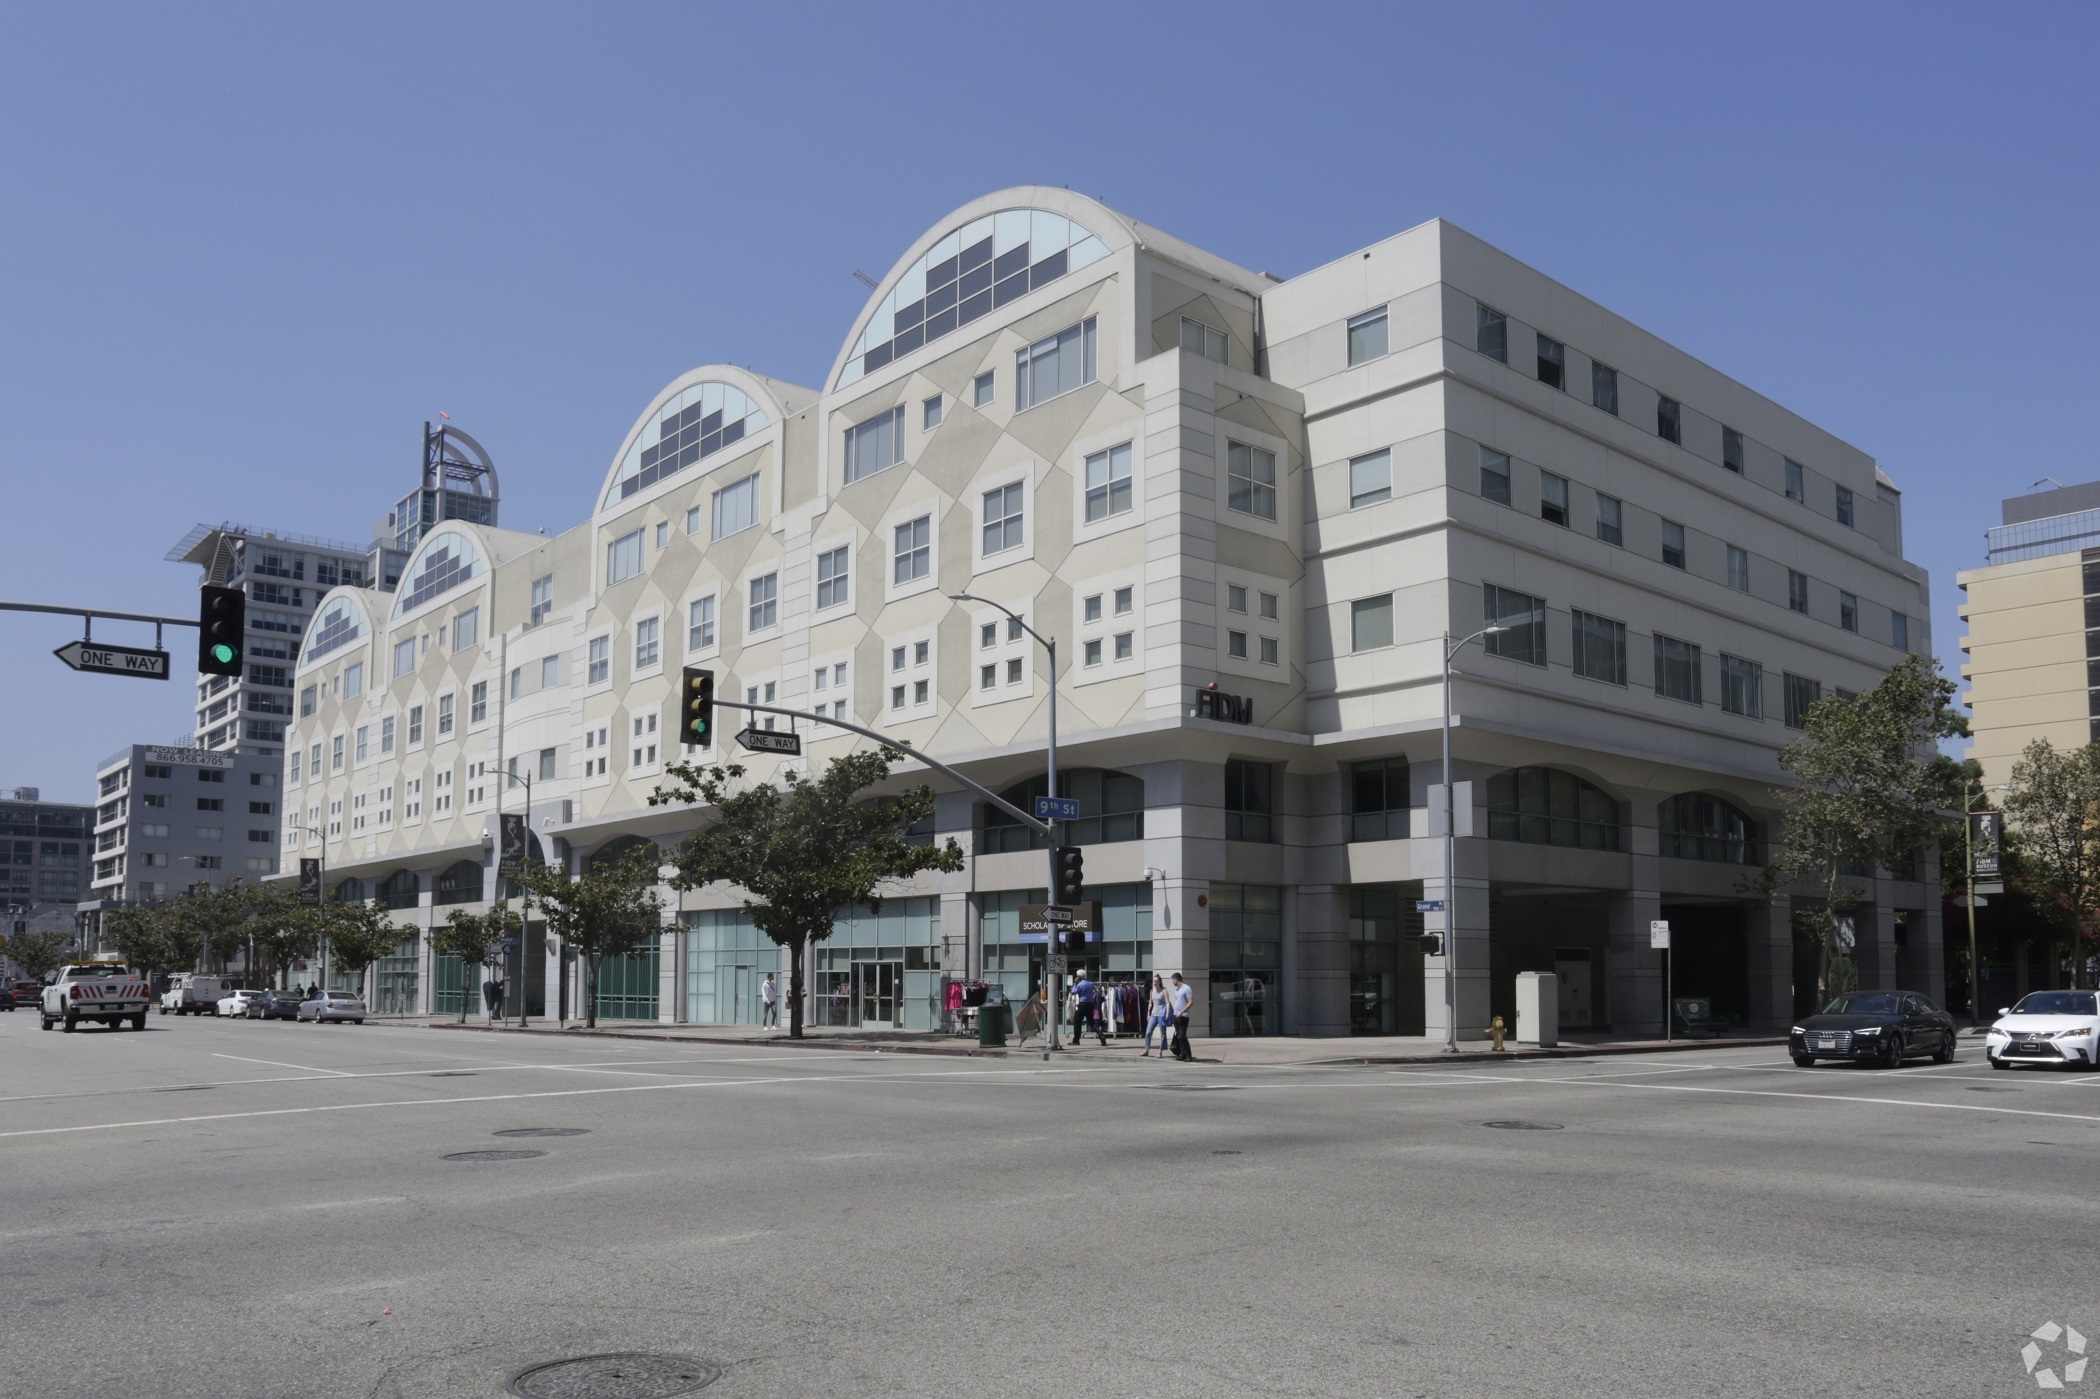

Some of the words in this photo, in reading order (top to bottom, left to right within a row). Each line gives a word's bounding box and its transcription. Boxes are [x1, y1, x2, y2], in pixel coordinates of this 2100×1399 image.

[80, 650, 113, 666] ONE
[125, 655, 159, 671] WAY
[750, 735, 768, 747] ONE
[774, 737, 794, 749] WAY
[152, 746, 178, 754] NOW
[184, 748, 228, 758] LEASING
[1040, 801, 1059, 814] 9th
[1063, 804, 1075, 815] St
[1051, 911, 1060, 919] ONE
